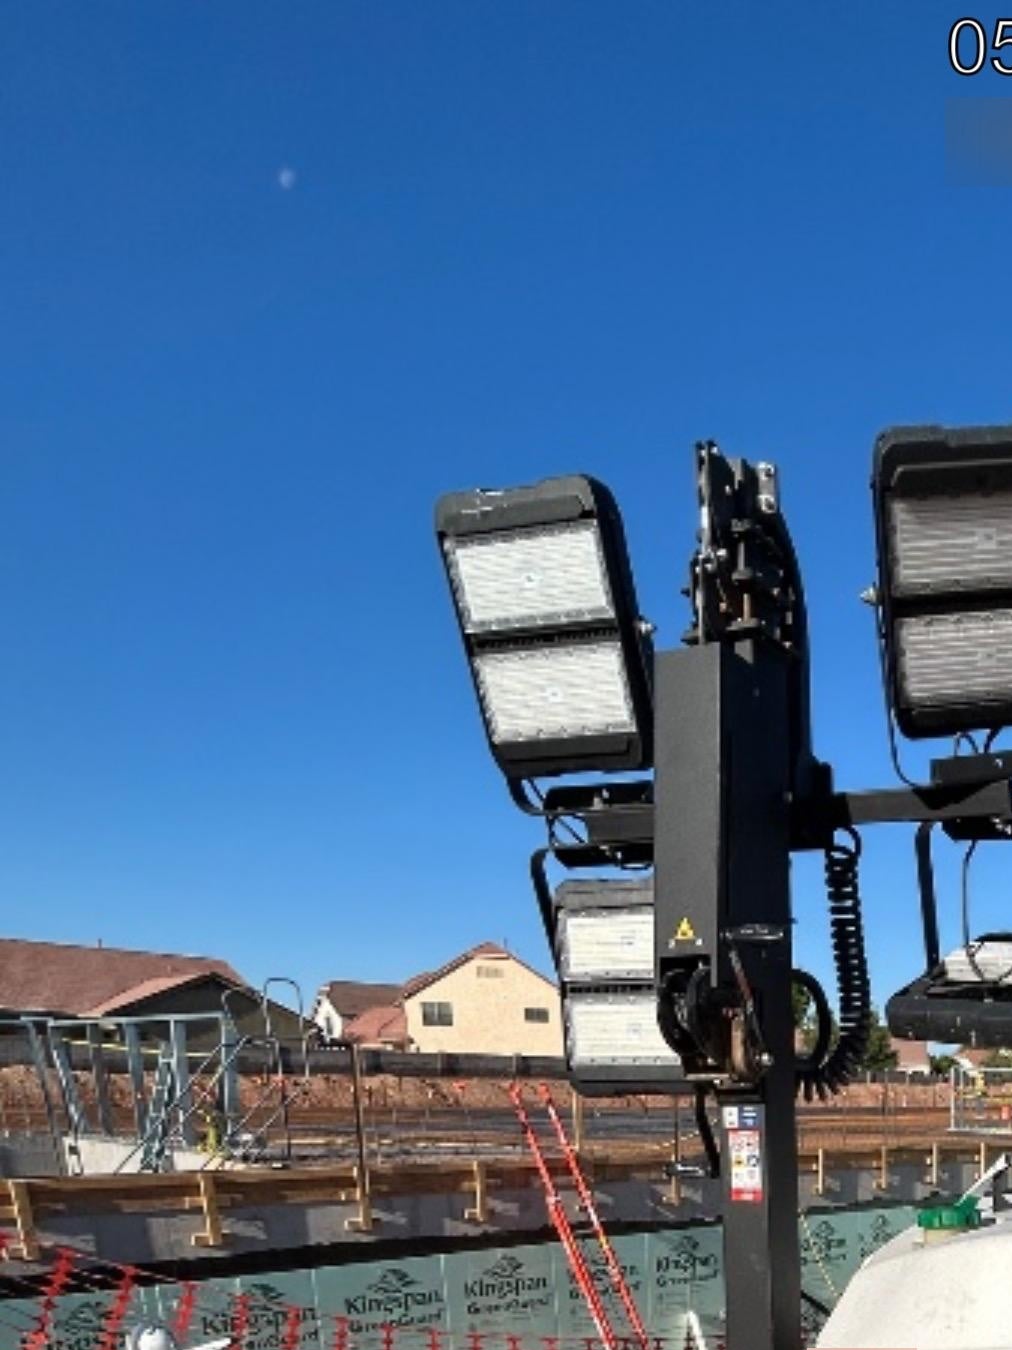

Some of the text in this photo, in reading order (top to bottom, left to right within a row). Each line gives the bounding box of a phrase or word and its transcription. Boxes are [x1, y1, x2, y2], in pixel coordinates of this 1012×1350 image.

[464, 1276, 548, 1300] Kingspan
[344, 1289, 444, 1315] Kingspan
[202, 1307, 318, 1337] Kigspn
